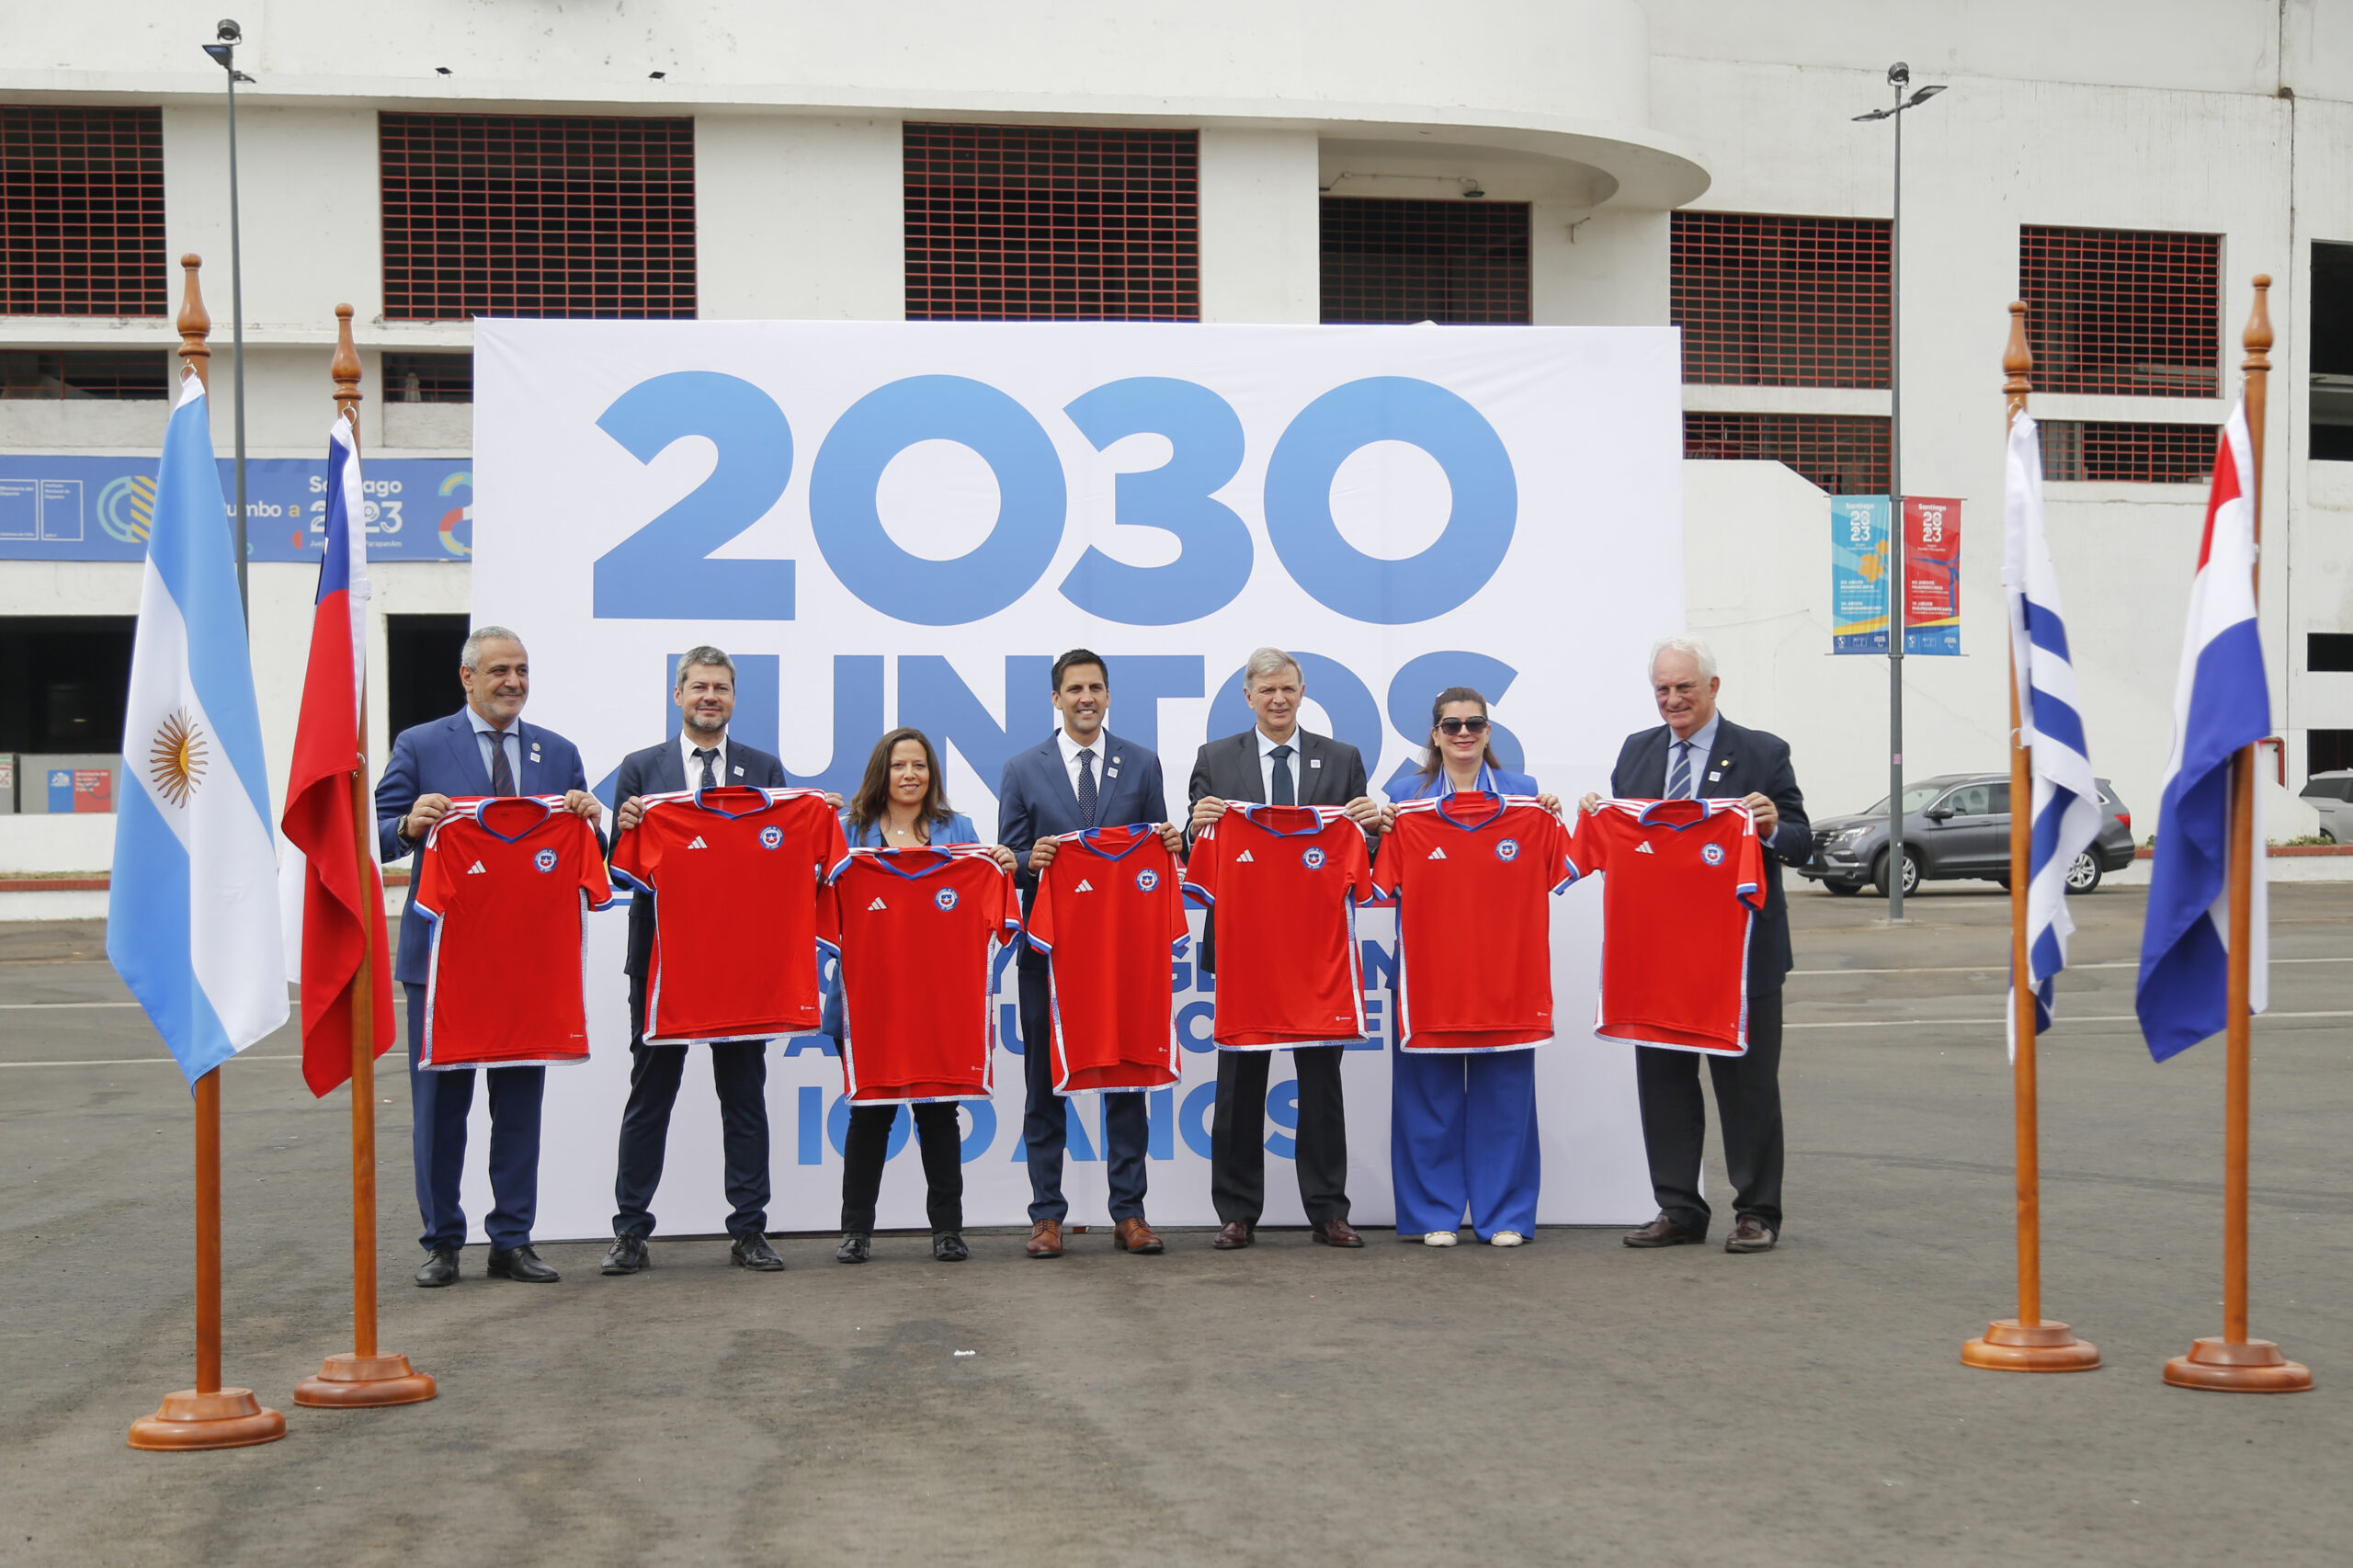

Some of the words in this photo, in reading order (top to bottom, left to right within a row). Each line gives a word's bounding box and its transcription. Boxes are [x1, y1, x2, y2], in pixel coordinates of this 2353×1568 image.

[310, 475, 403, 497] Sago
[593, 369, 1518, 626] 2030
[226, 500, 282, 517] umbo
[289, 505, 301, 517] a
[310, 500, 403, 533] 223
[1850, 510, 1870, 526] 20
[1923, 511, 1942, 527] 20
[1850, 526, 1870, 541] 23
[1923, 527, 1942, 542] 23
[591, 650, 1526, 812] UNTOS
